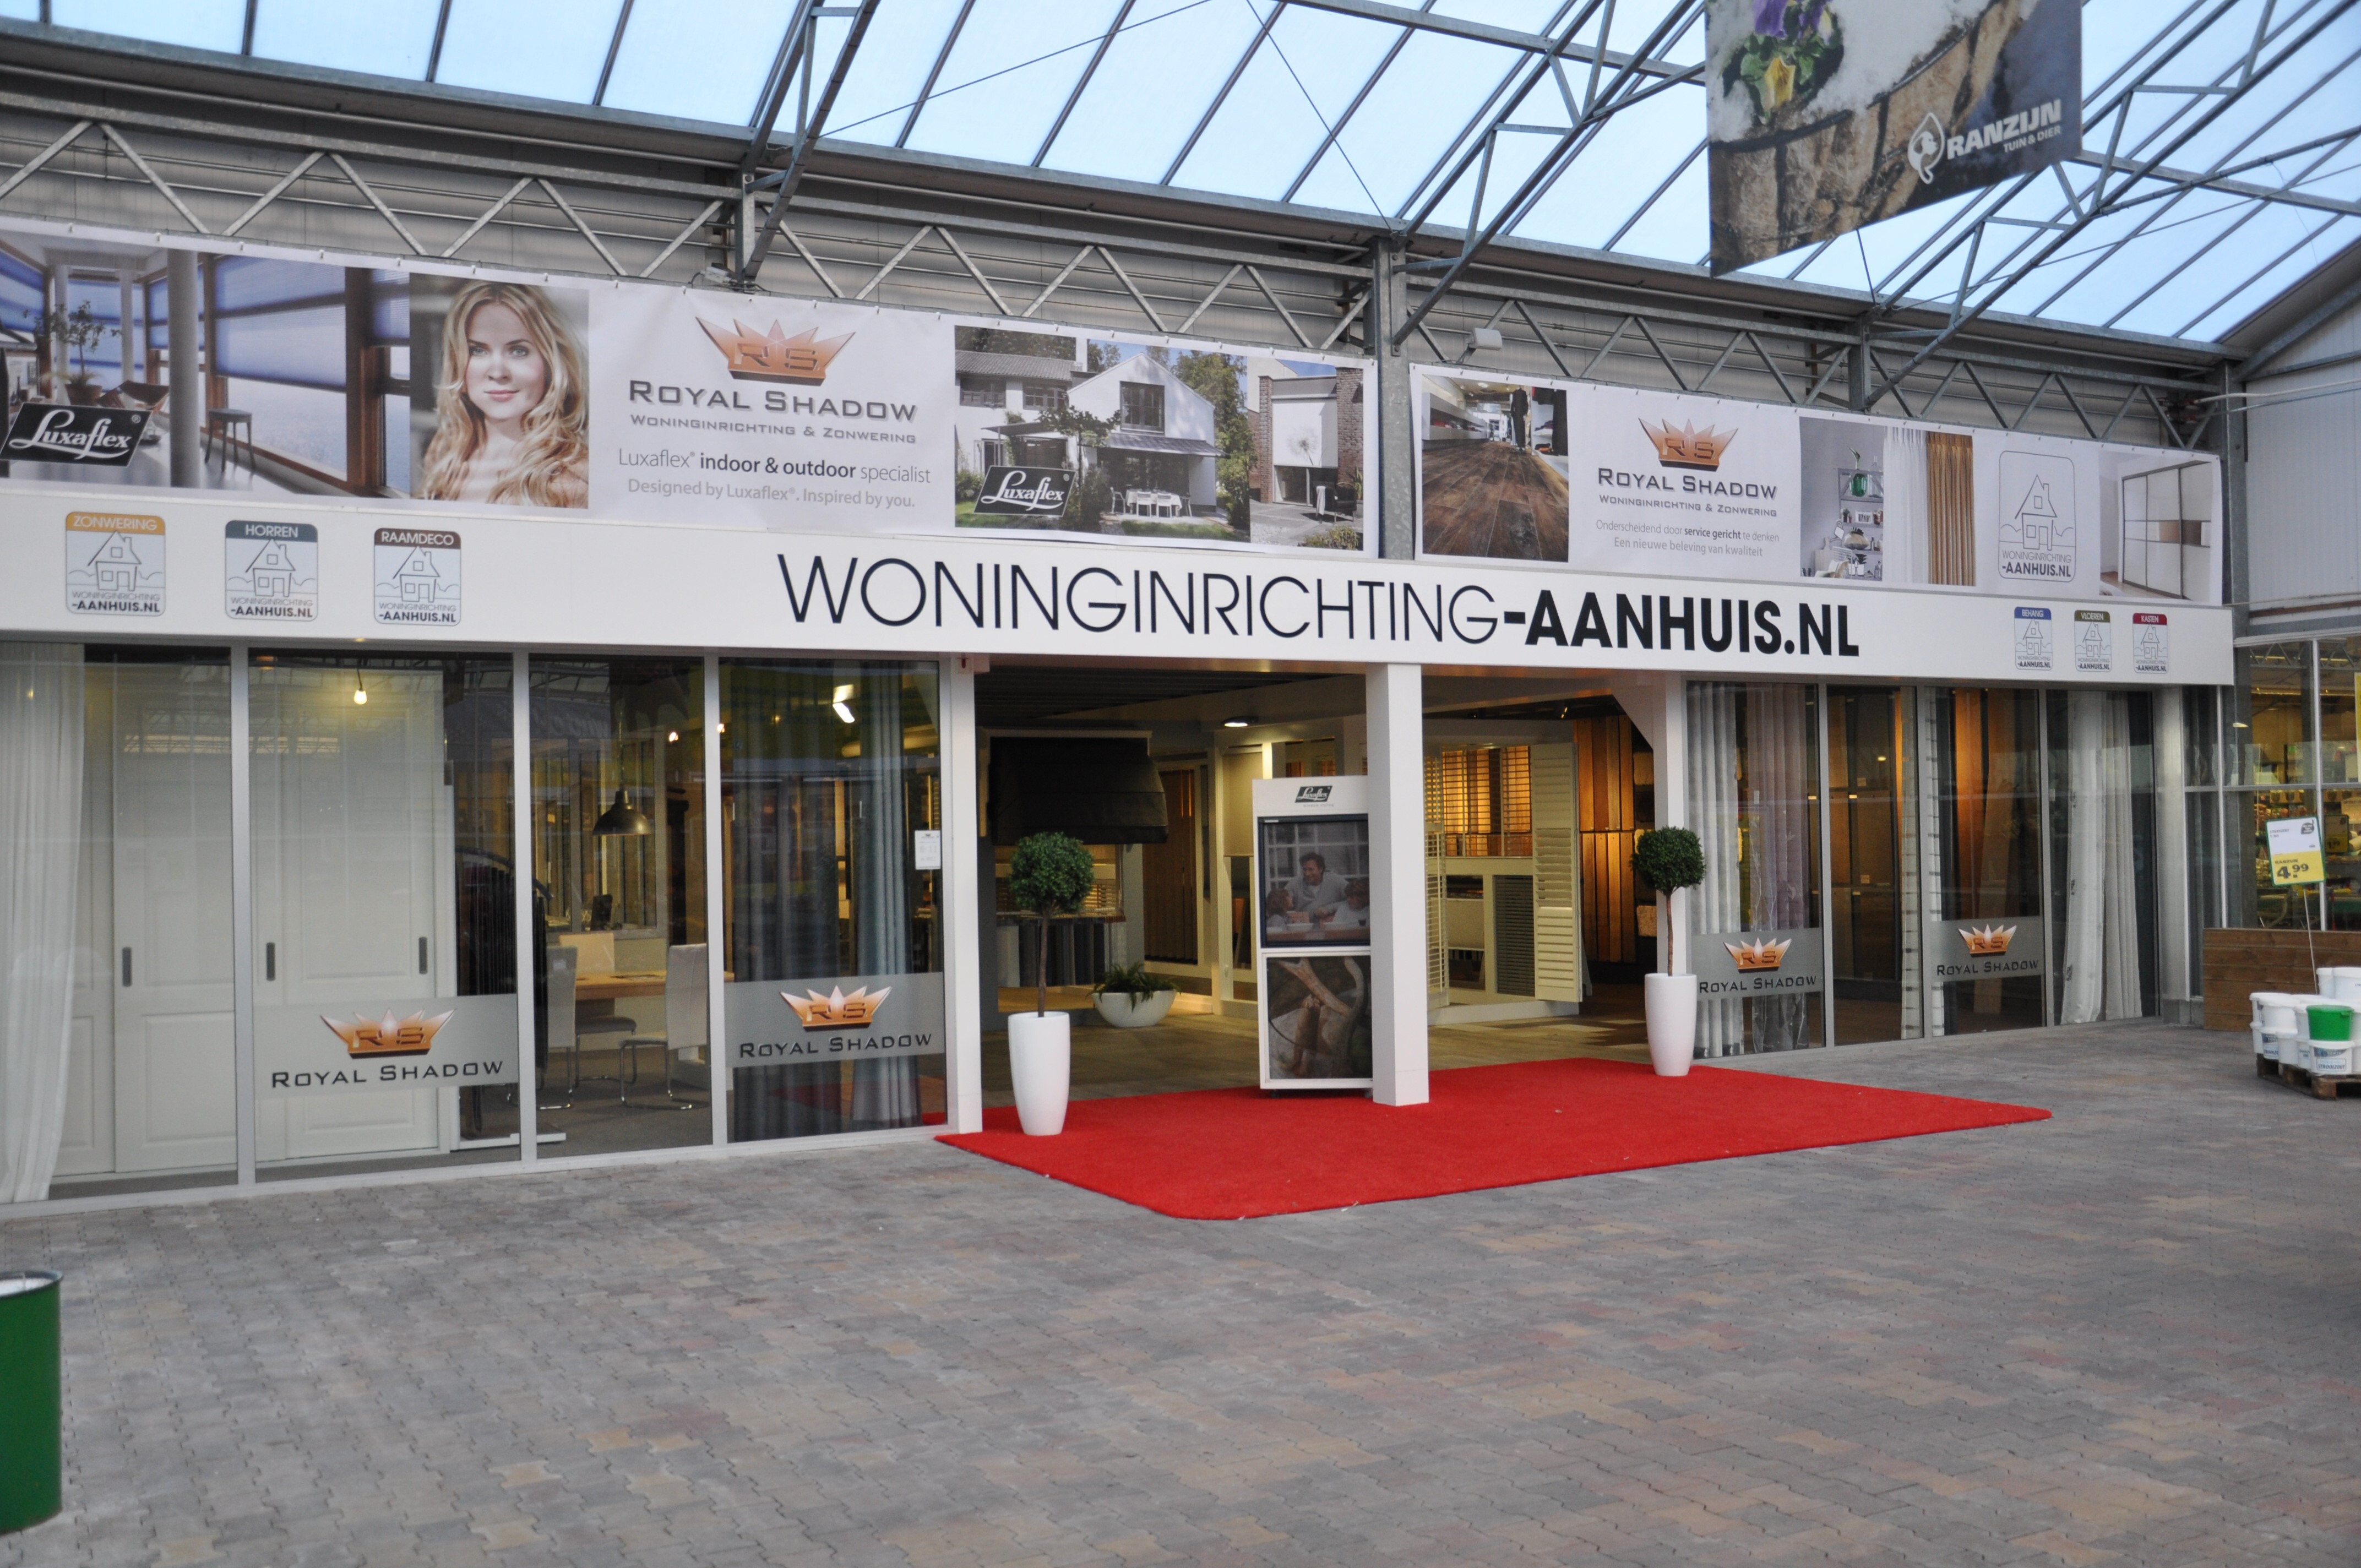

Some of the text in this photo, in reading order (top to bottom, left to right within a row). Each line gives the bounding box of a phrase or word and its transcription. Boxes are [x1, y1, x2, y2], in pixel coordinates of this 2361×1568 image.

[1947, 99, 2061, 160] RANZIJN
[2004, 126, 2061, 153] TUIN & DIER
[630, 380, 916, 422] ROYAL SHADOW
[631, 414, 916, 443] WONINGINRICHTING & ZONWERING
[700, 452, 760, 473] indoor
[765, 458, 779, 474] &
[783, 459, 856, 478] outdoor
[861, 465, 931, 484] specialist
[1598, 468, 1777, 499] ROYAL SHADOW
[628, 478, 702, 498] Designed
[706, 481, 723, 499] by
[803, 488, 861, 506] Inspired
[864, 491, 882, 508] by
[885, 494, 915, 510] you.
[1599, 494, 1777, 517] WONINGINRICHTING & ZONWERING
[73, 516, 157, 530] ZONWERING
[246, 525, 298, 537] HORREN
[1596, 520, 1661, 533] Onderscheidend
[1663, 522, 1682, 535] door
[1684, 527, 1711, 537] service
[1712, 529, 1741, 540] gericht
[1752, 531, 1779, 542] denken
[382, 531, 454, 546] RAAMDECO
[1614, 537, 1762, 557] Een nieuwe beleving van kwaliteit
[2002, 551, 2072, 563] WONINGINRICHTING
[231, 597, 313, 606] WONINGINRICHTING
[379, 602, 456, 612] WONINGINRICHTING
[2022, 609, 2044, 618] BEHANG
[2080, 612, 2104, 620] VLOEREN
[2141, 615, 2159, 623] KASTEN
[1937, 960, 2038, 976] ROYAL SHADOW
[1699, 976, 1816, 993] ROYAL SHADOW
[740, 1033, 932, 1058] ROYAL SHADOW
[272, 1061, 503, 1088] ROYAL SHADOW
